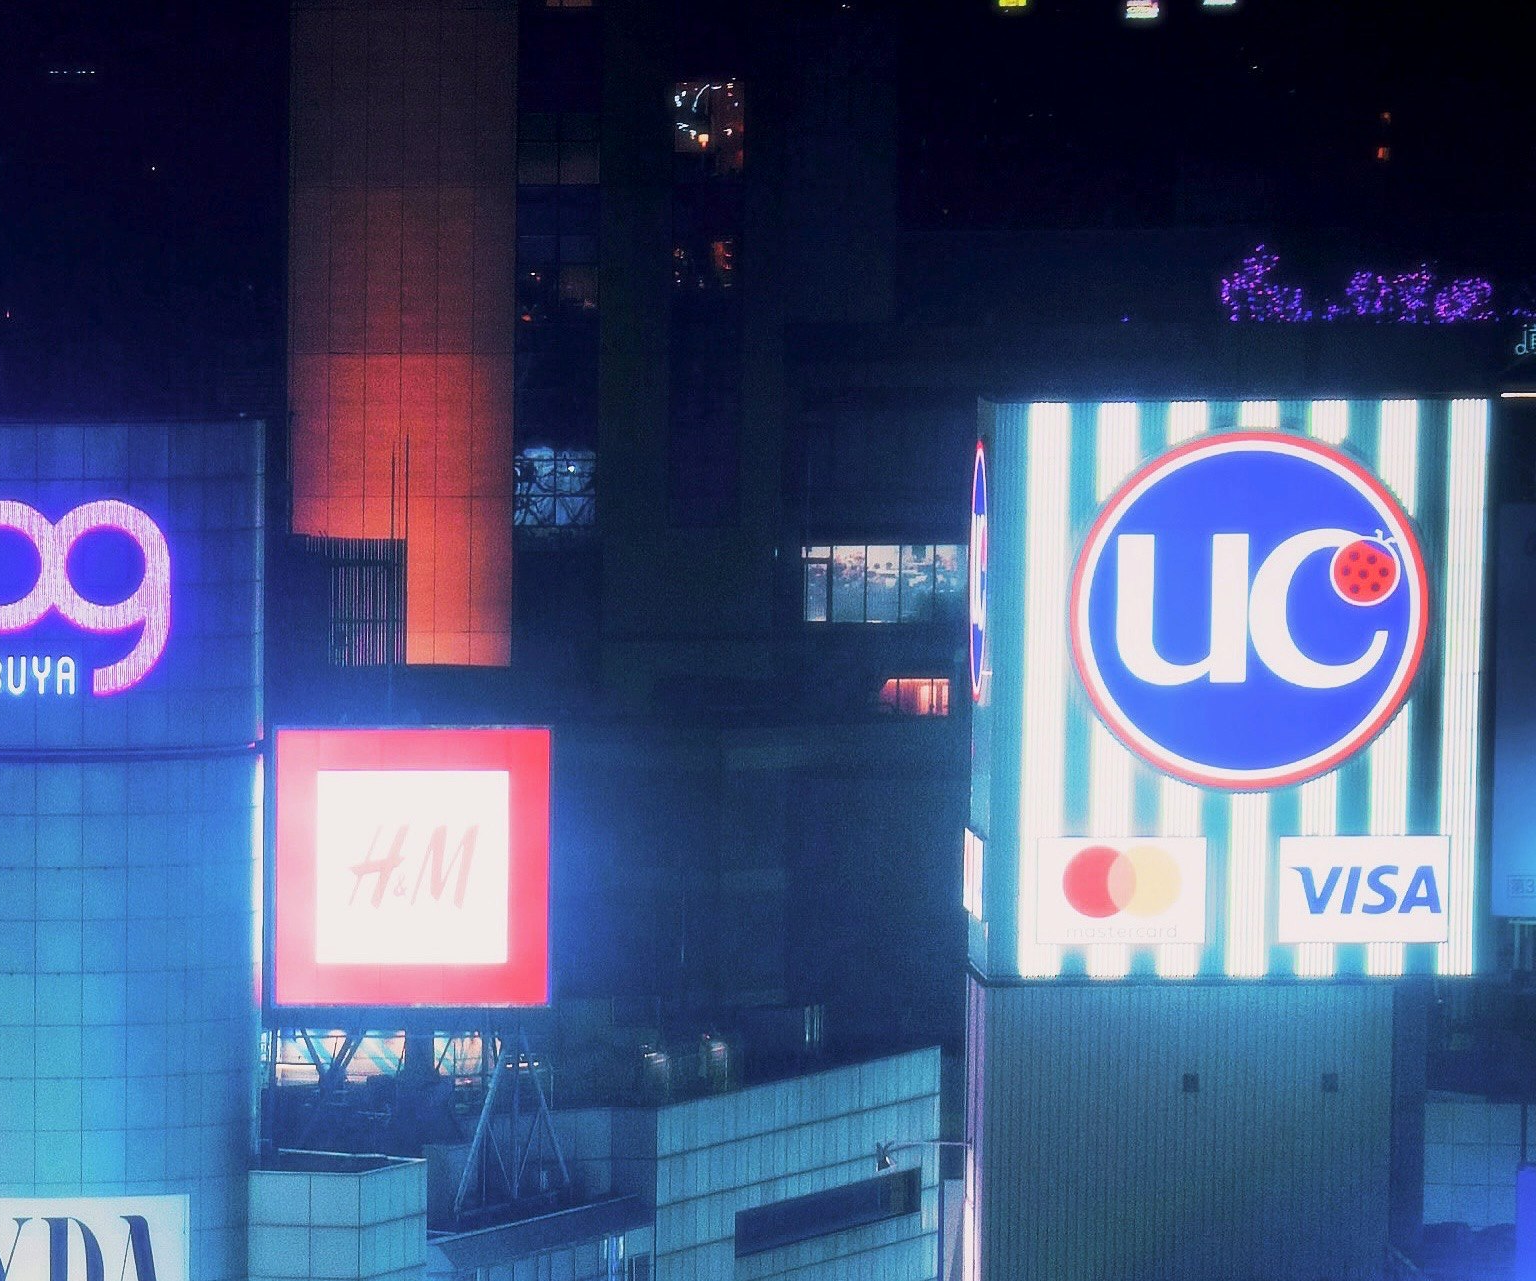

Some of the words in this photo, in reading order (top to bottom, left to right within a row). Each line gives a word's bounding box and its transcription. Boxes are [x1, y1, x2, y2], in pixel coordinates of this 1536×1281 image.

[348, 823, 479, 912] H&M
[1290, 864, 1442, 916] VISA
[1065, 925, 1179, 940] mastercard
